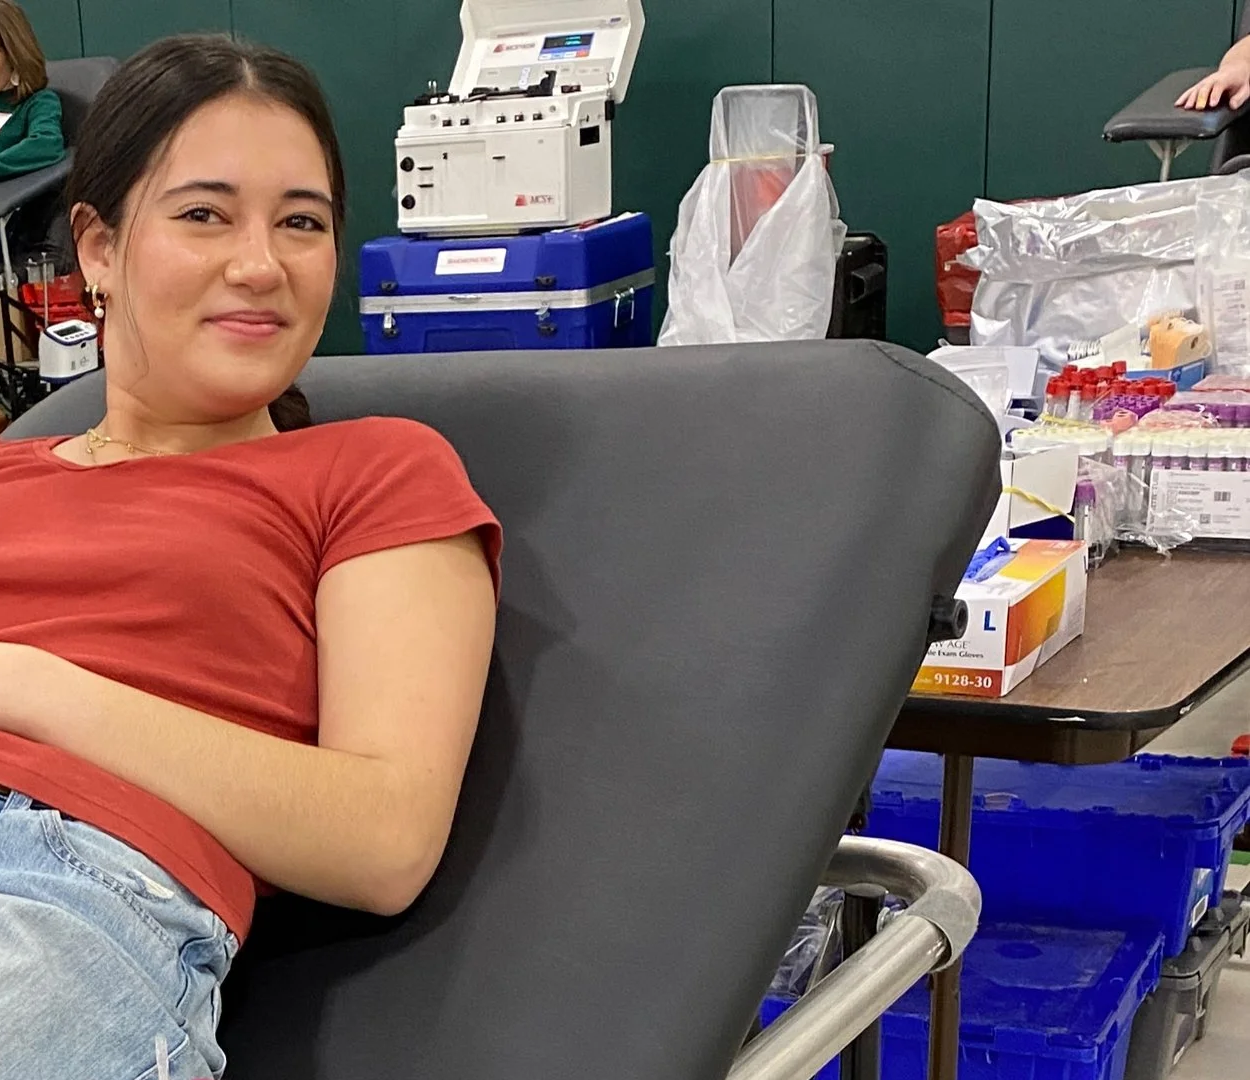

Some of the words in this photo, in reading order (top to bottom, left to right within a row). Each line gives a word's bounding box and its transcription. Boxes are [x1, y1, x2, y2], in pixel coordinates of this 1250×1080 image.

[983, 610, 996, 631] L
[938, 650, 957, 658] Exam
[934, 673, 992, 688] 9128-30
